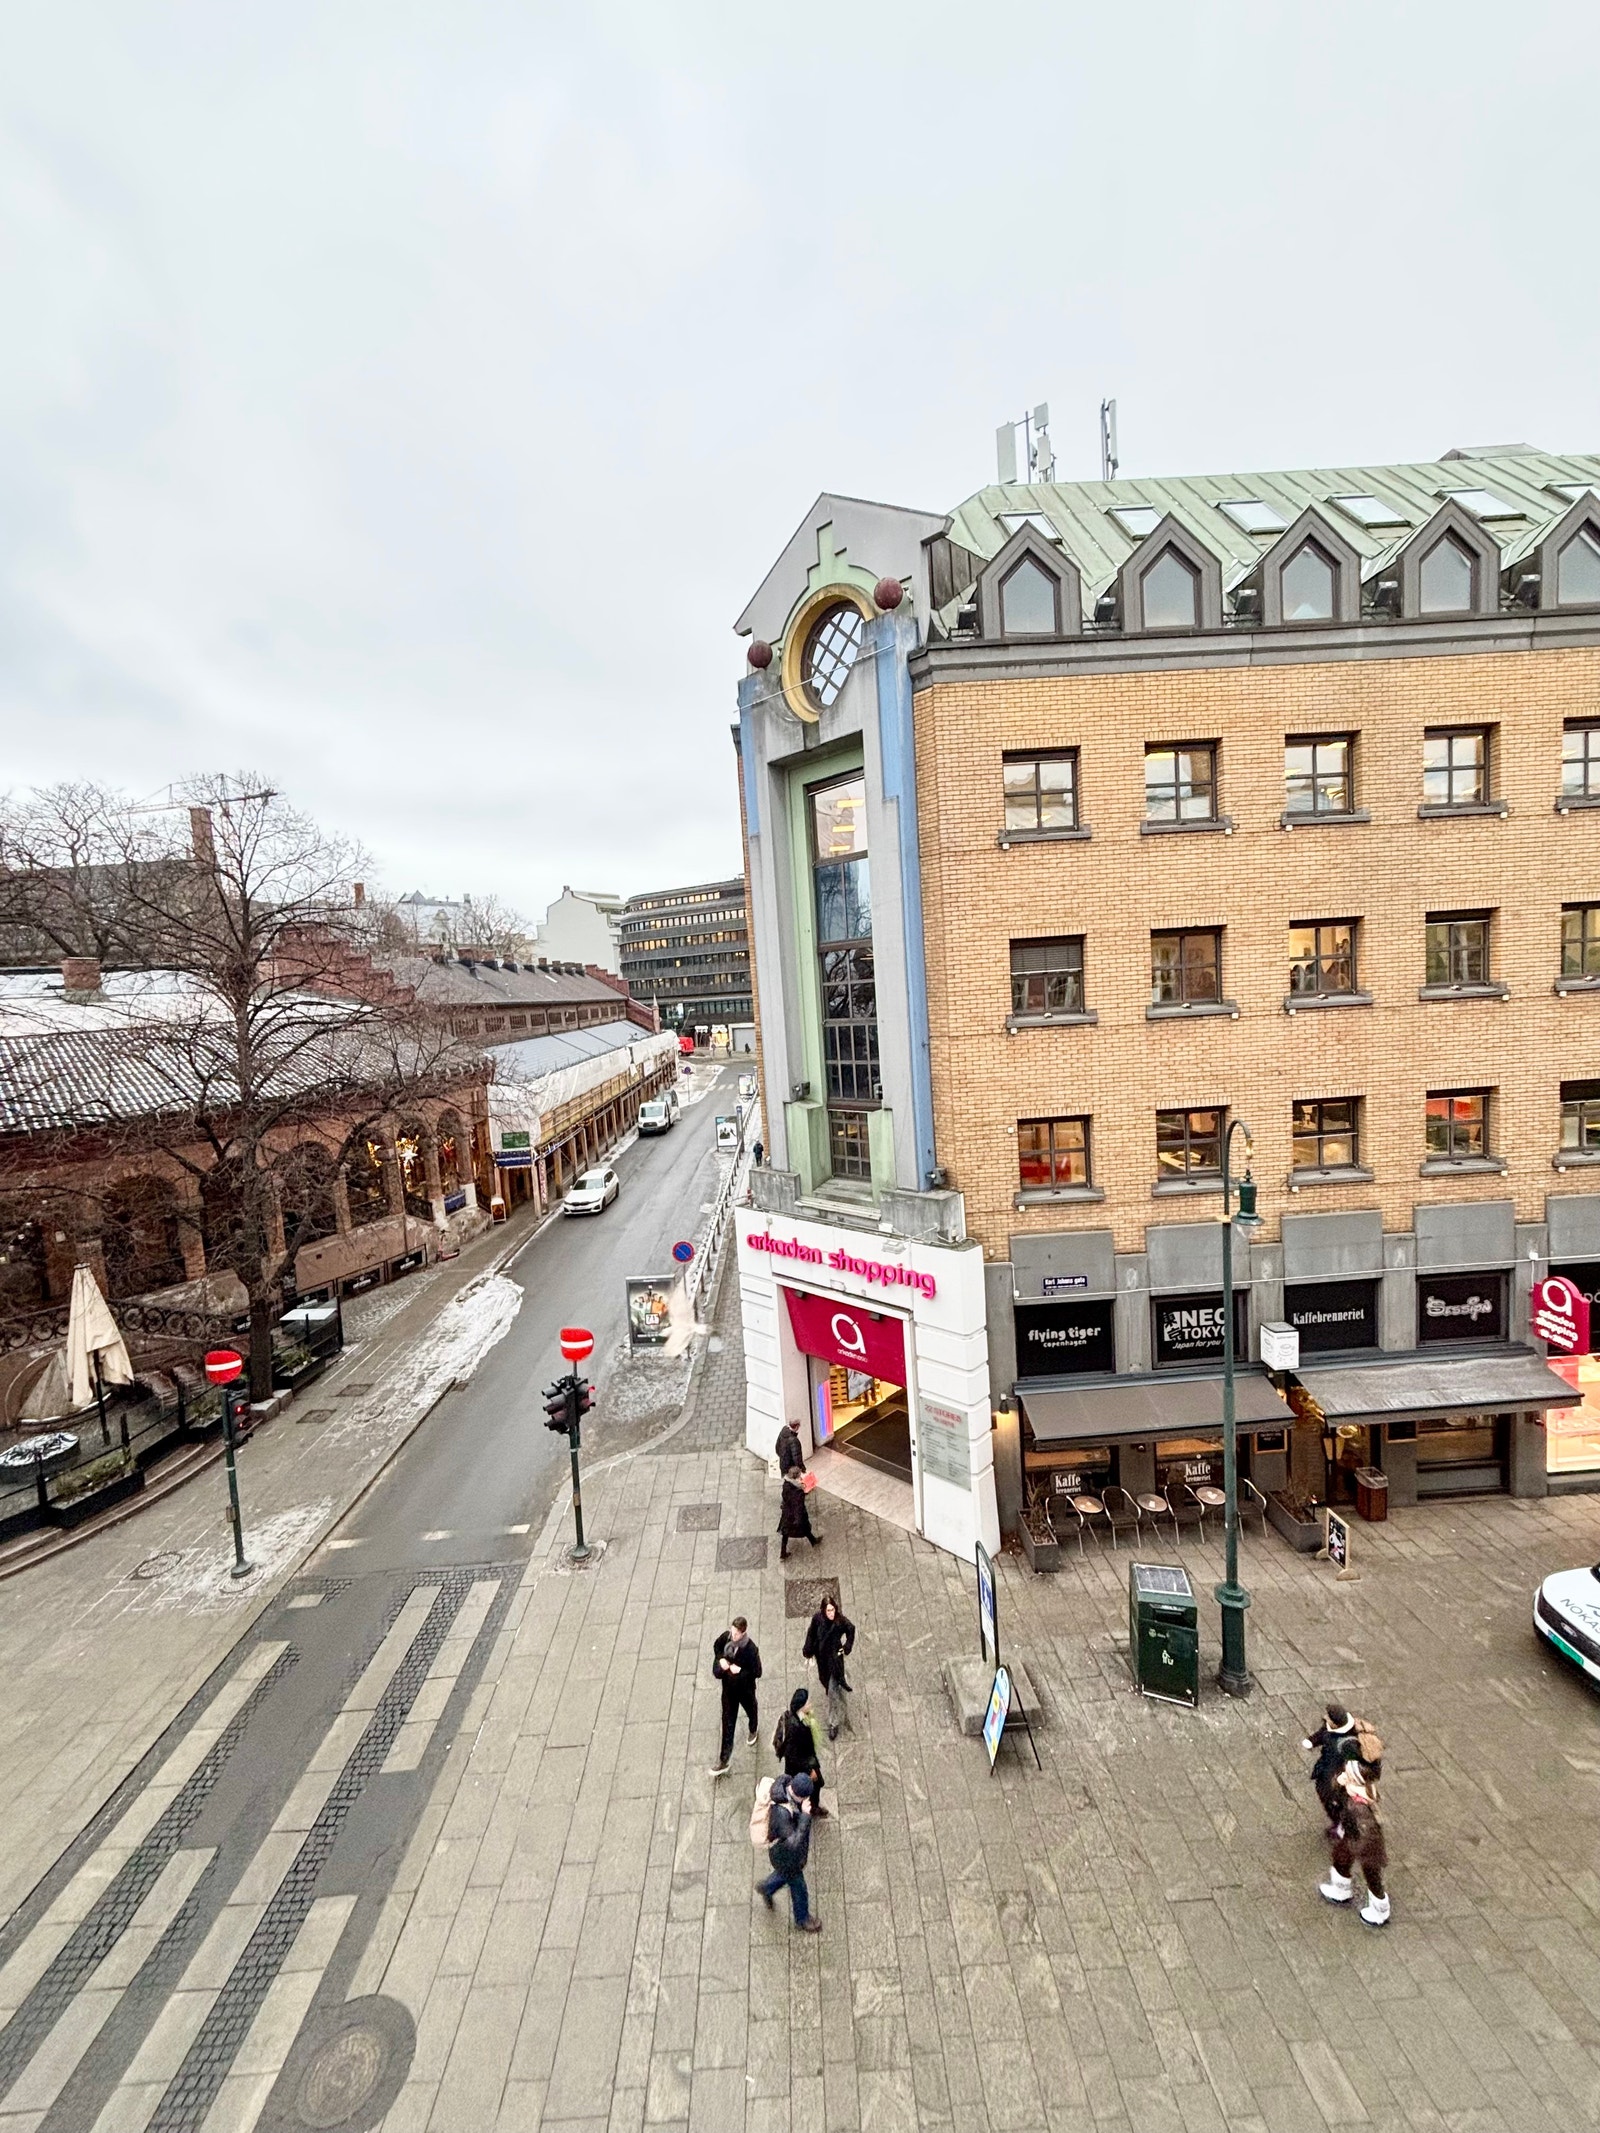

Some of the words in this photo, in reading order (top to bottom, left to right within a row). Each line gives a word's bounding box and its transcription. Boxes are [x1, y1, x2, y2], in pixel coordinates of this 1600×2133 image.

[746, 1231, 822, 1264] arkaden
[828, 1248, 936, 1299] shopping
[1293, 1308, 1365, 1325] Kaffebrenneriet
[1028, 1328, 1067, 1343] flying
[1067, 1326, 1101, 1339] tiger
[1535, 1316, 1579, 1342] shopping
[1043, 1339, 1087, 1348] copenhagen
[1172, 1341, 1195, 1350] Japan
[1195, 1340, 1206, 1348] for
[1206, 1339, 1221, 1348] you
[1185, 1462, 1211, 1476] Kaffe
[1055, 1473, 1081, 1488] Kaffe
